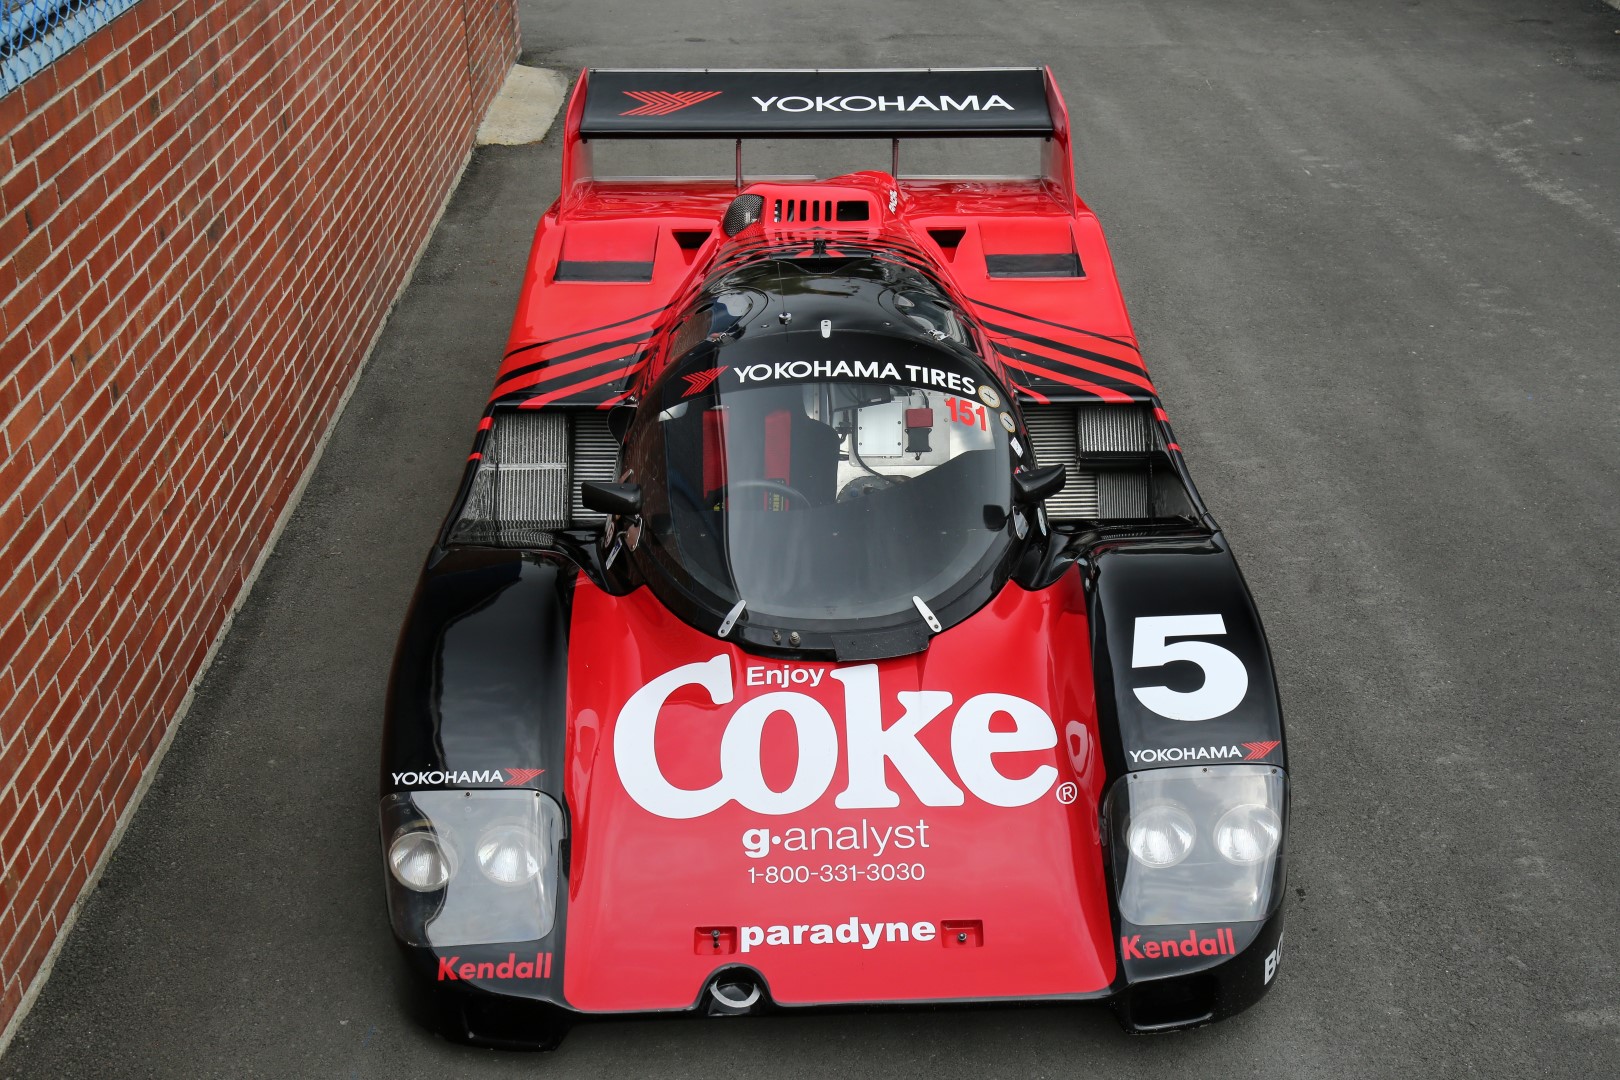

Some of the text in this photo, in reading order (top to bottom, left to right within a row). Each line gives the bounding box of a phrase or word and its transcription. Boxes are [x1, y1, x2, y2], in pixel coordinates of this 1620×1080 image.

[752, 95, 1015, 113] YOKOHAMA
[733, 360, 977, 395] YOKOHAMA TIRES
[945, 396, 987, 431] 151
[746, 664, 825, 689] Enjoy
[1132, 613, 1249, 721] 5
[613, 653, 1059, 820] Coke
[1128, 745, 1243, 763] YOKOHAMA
[391, 769, 504, 785] YOKOHAMA
[747, 862, 926, 884] 1-800-331-3030
[740, 916, 936, 953] paradyne
[1121, 927, 1236, 961] Kendall
[437, 952, 553, 981] Kendall
